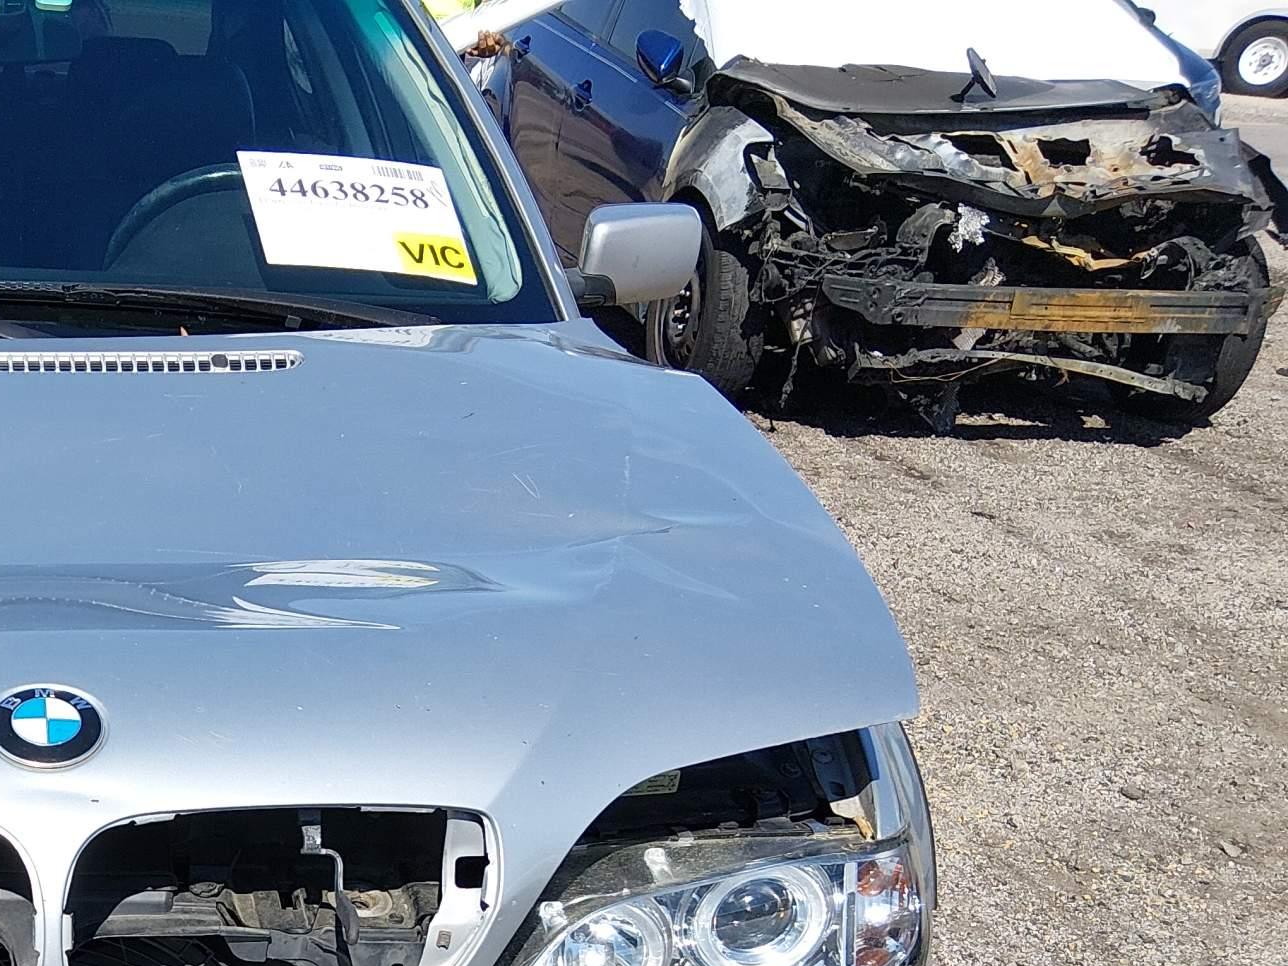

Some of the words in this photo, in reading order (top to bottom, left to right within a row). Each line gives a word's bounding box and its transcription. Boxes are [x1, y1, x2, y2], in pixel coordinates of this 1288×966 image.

[269, 177, 430, 210] 44638258
[398, 240, 465, 269] VIC
[0, 688, 92, 710] BMW
